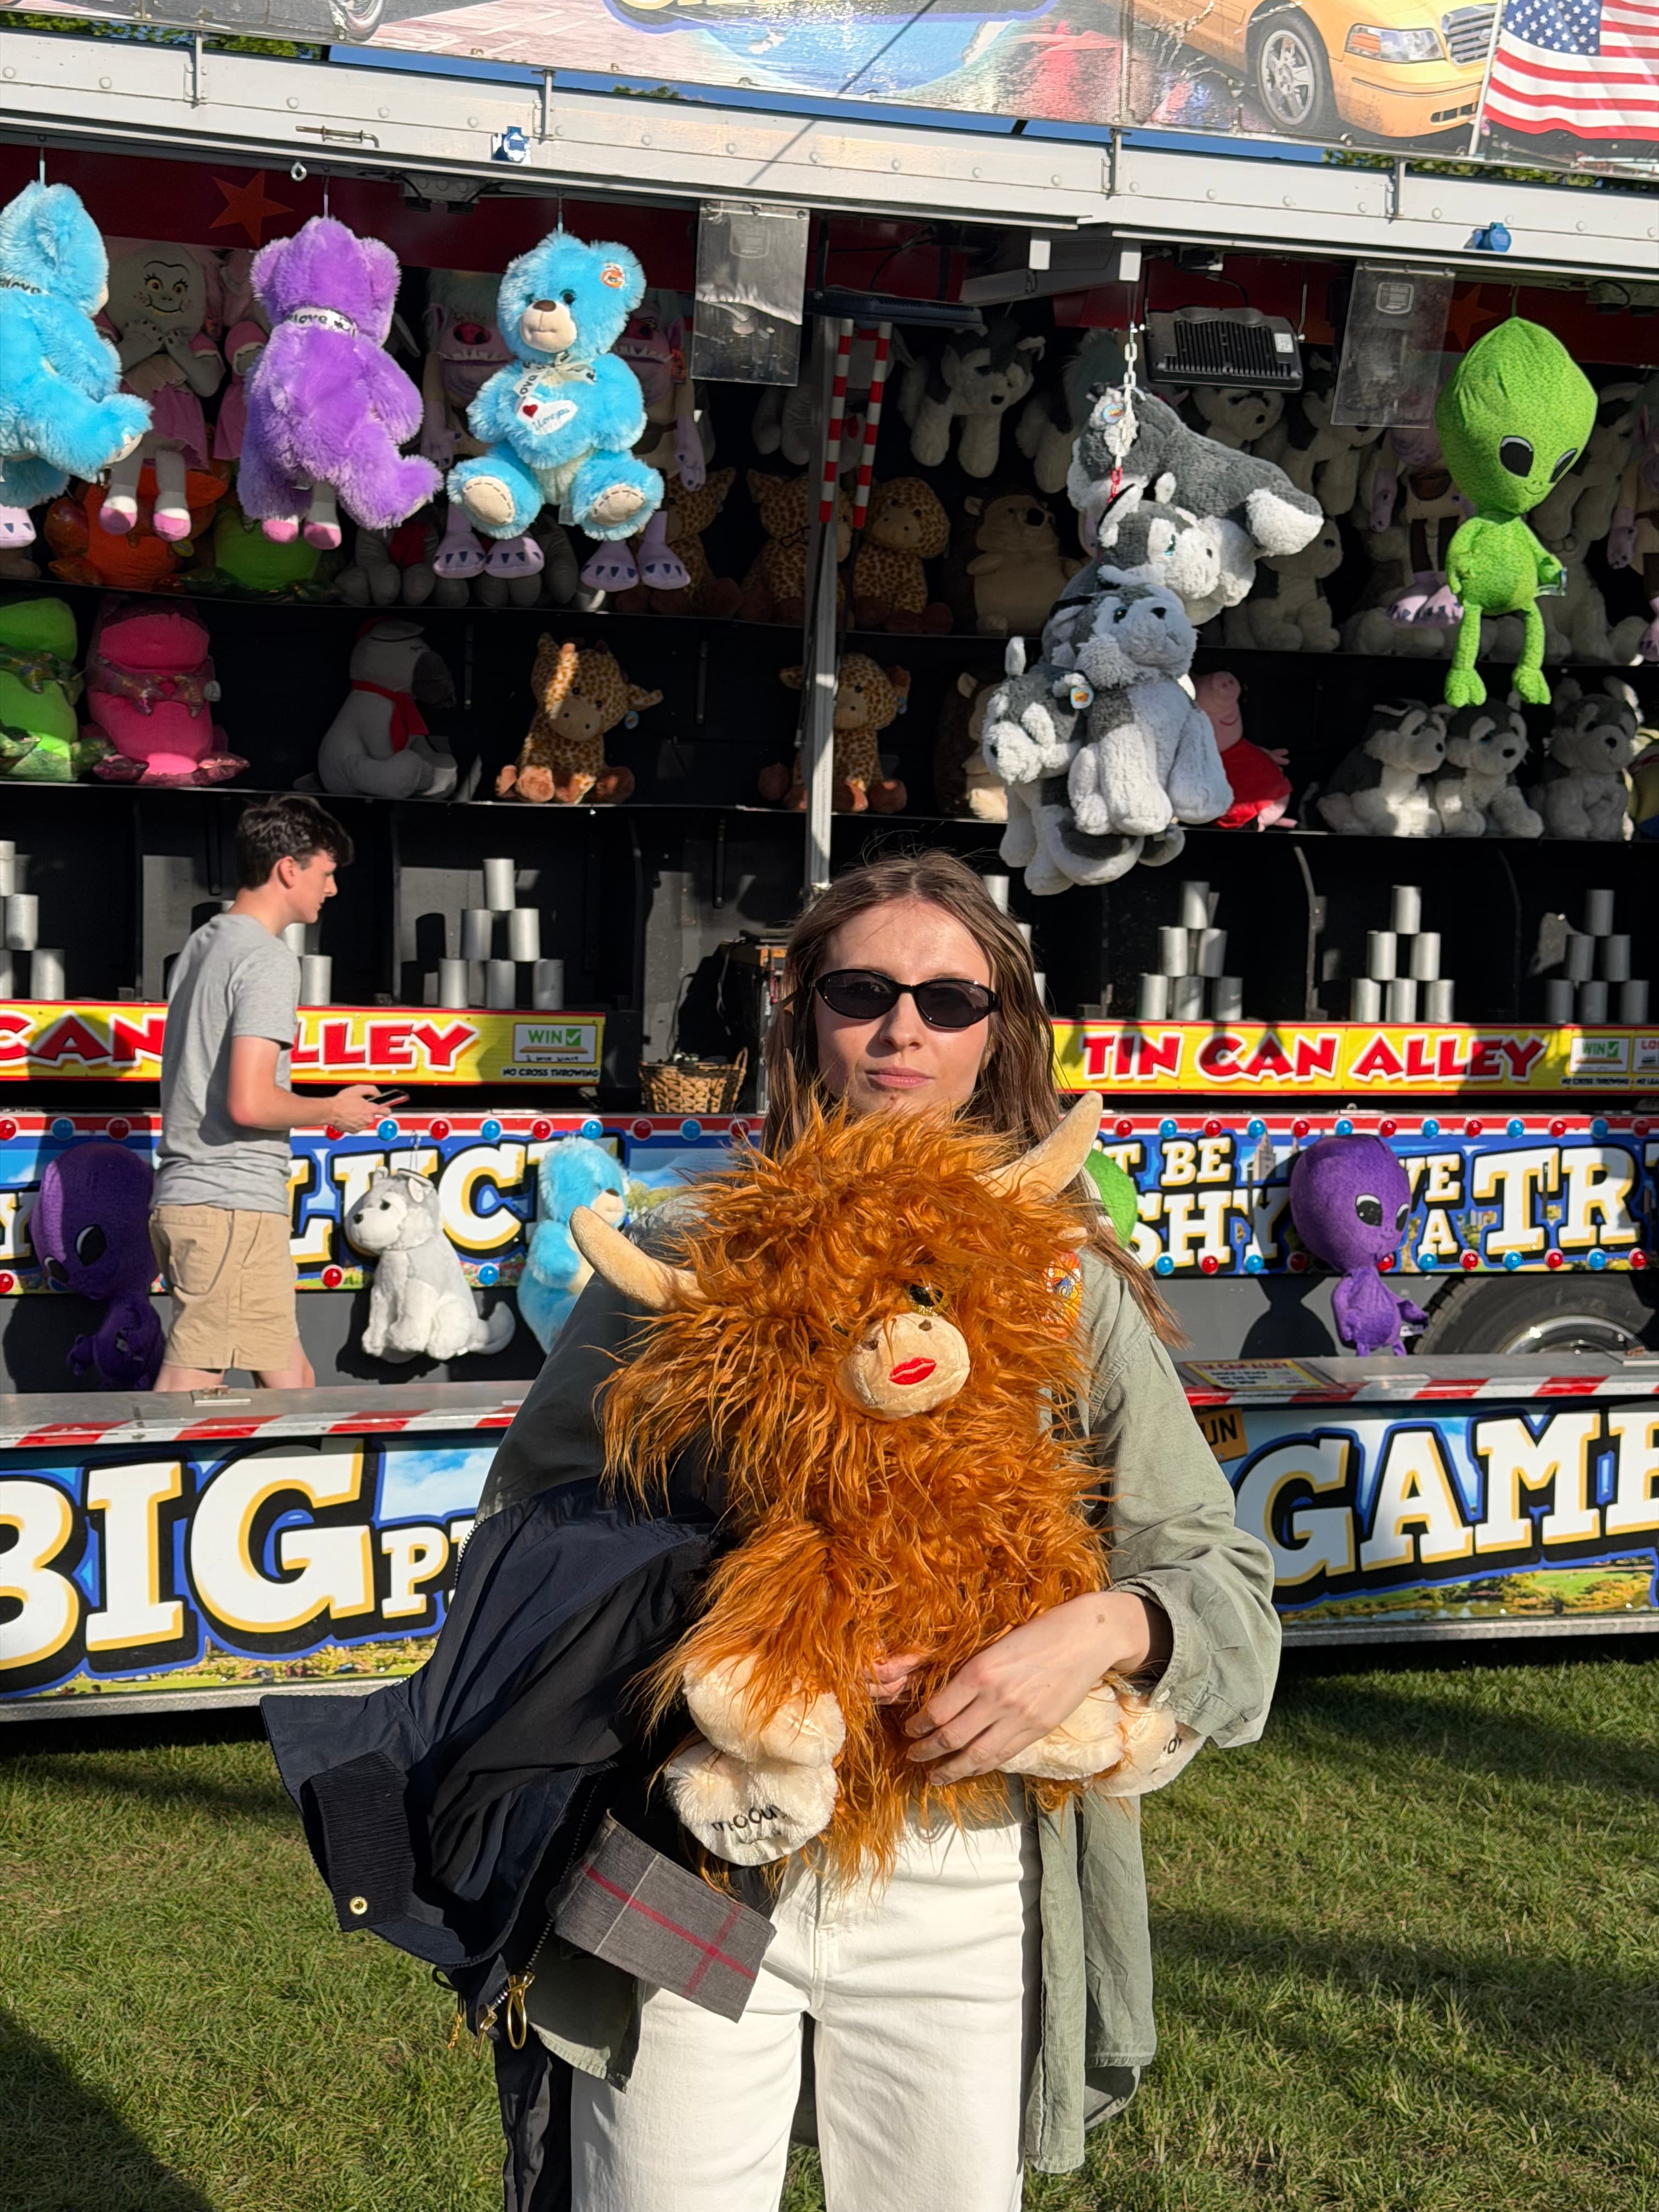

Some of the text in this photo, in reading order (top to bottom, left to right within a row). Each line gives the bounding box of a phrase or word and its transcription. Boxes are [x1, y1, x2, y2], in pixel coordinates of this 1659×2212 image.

[0, 1012, 166, 1063] CAN
[527, 1029, 563, 1044] WIN
[1080, 1034, 1547, 1081] TIN CAN ALLEY
[1582, 1042, 1606, 1055] WIN
[1640, 1040, 1659, 1051] LO
[502, 1068, 599, 1077] NO CROSS THROWING
[1160, 1137, 1232, 1187] BE
[1472, 1143, 1659, 1255] TR
[1129, 1186, 1291, 1271] SHY
[1417, 1209, 1459, 1257] A
[1235, 1412, 1659, 1587] GAME
[0, 1438, 375, 1670] BIG
